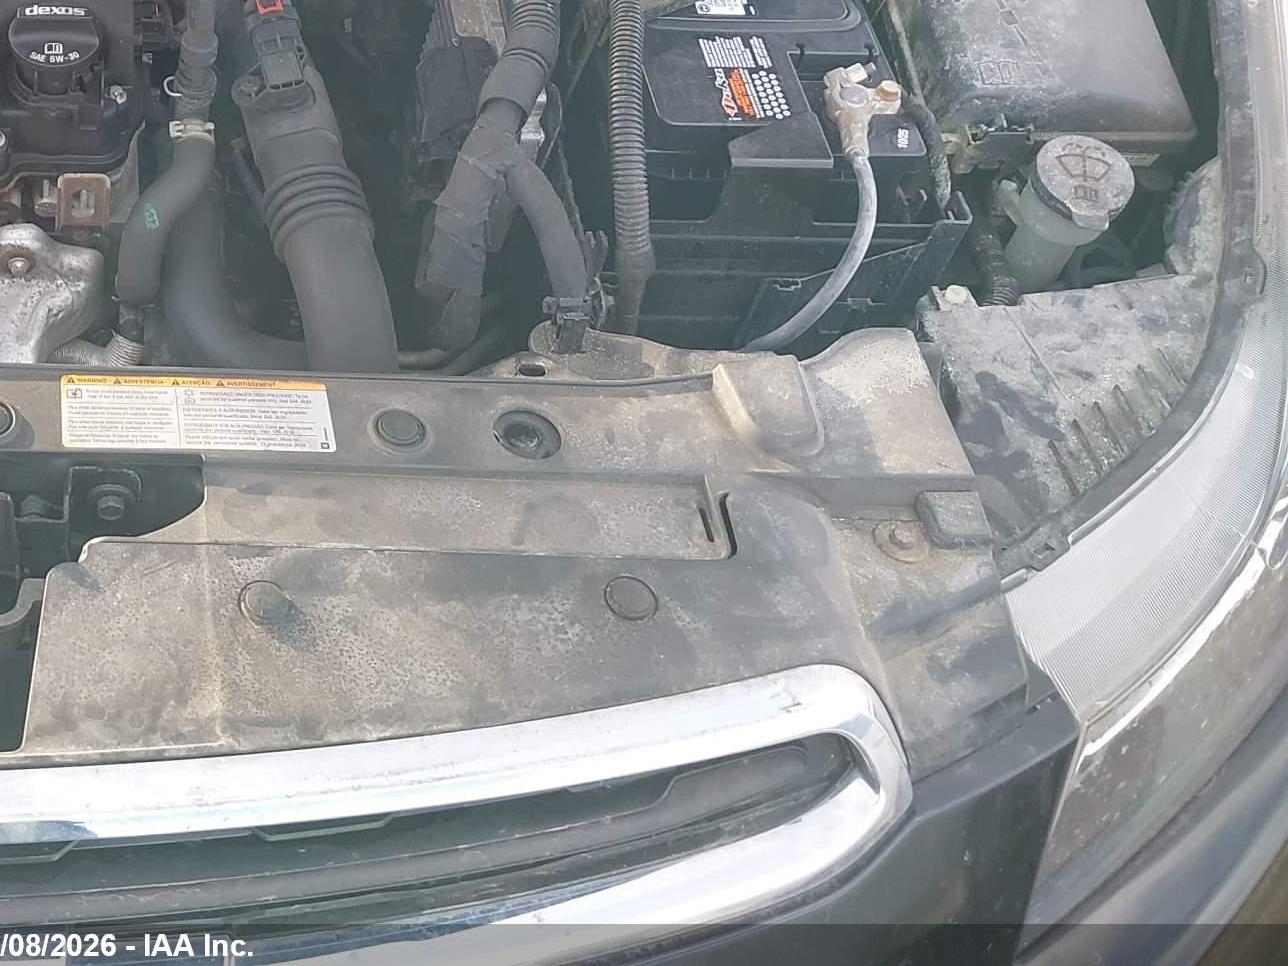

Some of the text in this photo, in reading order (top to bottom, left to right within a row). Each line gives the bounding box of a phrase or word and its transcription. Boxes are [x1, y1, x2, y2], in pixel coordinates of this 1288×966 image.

[24, 4, 88, 16] dexos
[29, 50, 80, 63] SAE 5W-30
